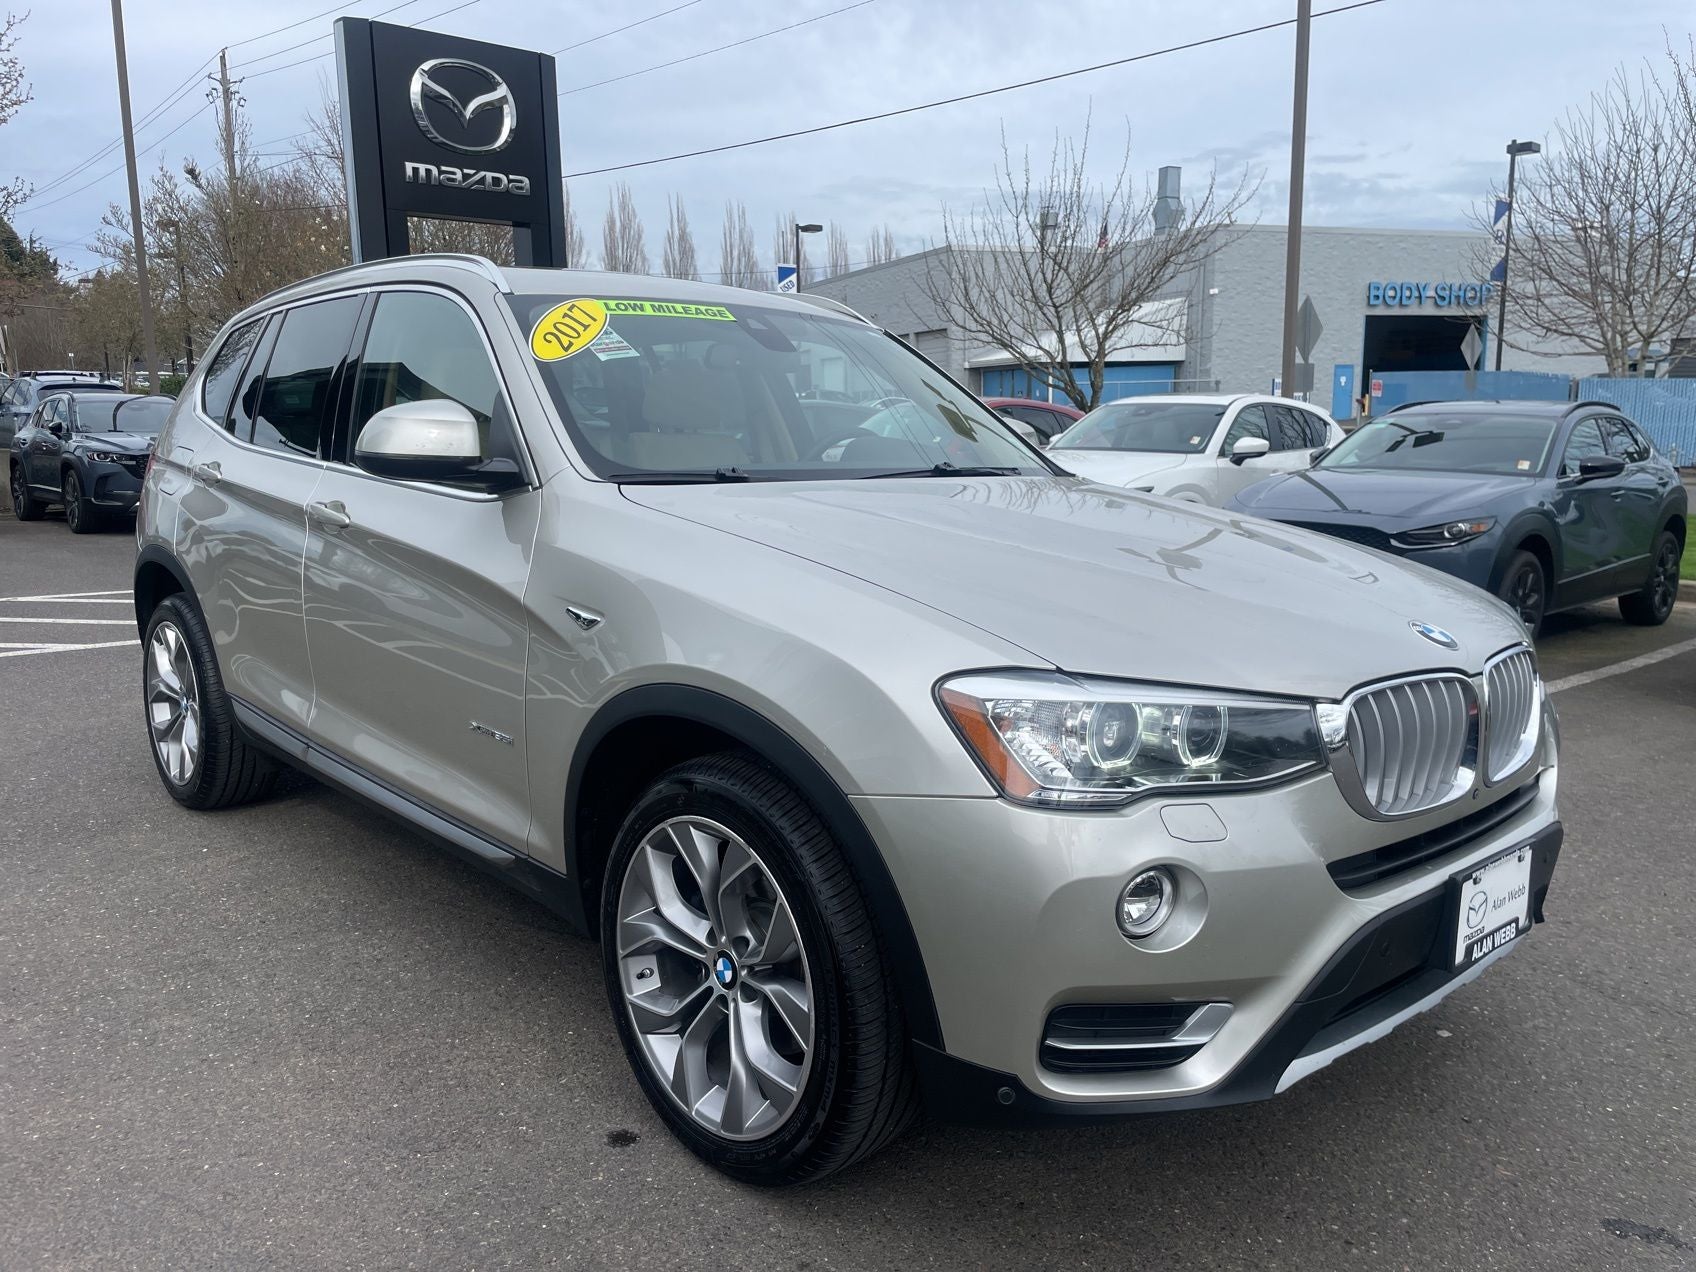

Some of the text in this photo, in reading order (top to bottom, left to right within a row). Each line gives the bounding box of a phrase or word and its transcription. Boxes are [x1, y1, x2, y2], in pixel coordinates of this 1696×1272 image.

[1368, 281, 1493, 308] BODY SHOP
[603, 301, 729, 319] LOW MILEAGE
[543, 303, 598, 352] 2017
[1491, 883, 1526, 912] Alan Webb
[1471, 922, 1516, 961] ALAN WEBB
